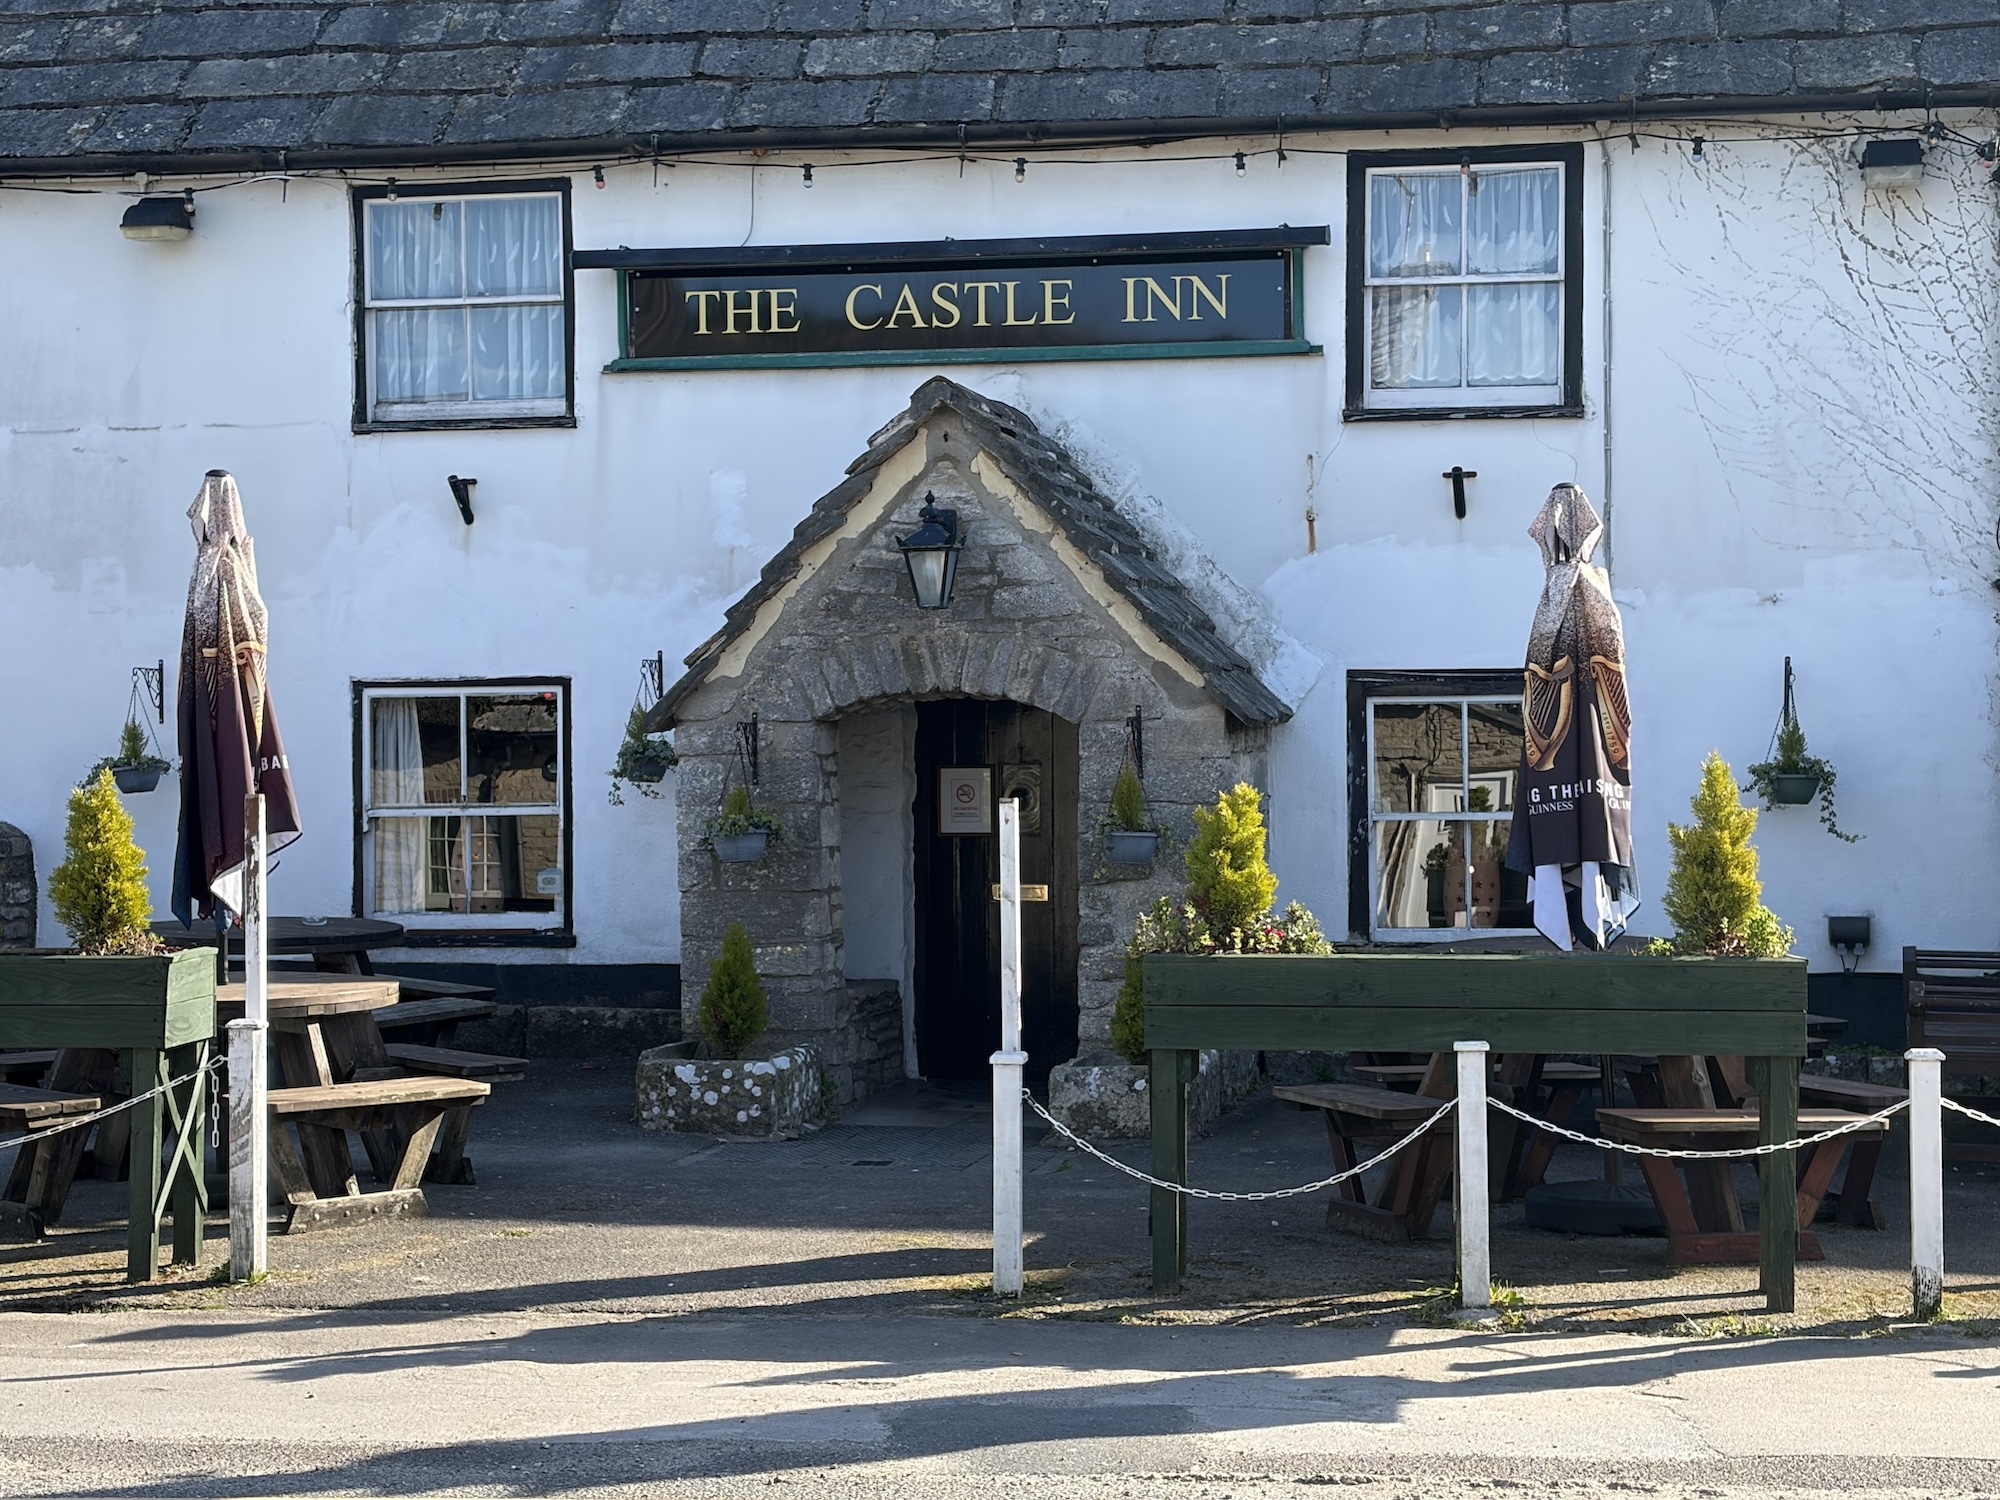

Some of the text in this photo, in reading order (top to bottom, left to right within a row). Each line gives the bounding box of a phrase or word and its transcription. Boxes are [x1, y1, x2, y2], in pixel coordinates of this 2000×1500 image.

[685, 274, 1232, 335] THE CASTLE INN
[1606, 731, 1620, 754] 1759
[1548, 783, 1579, 800] THE
